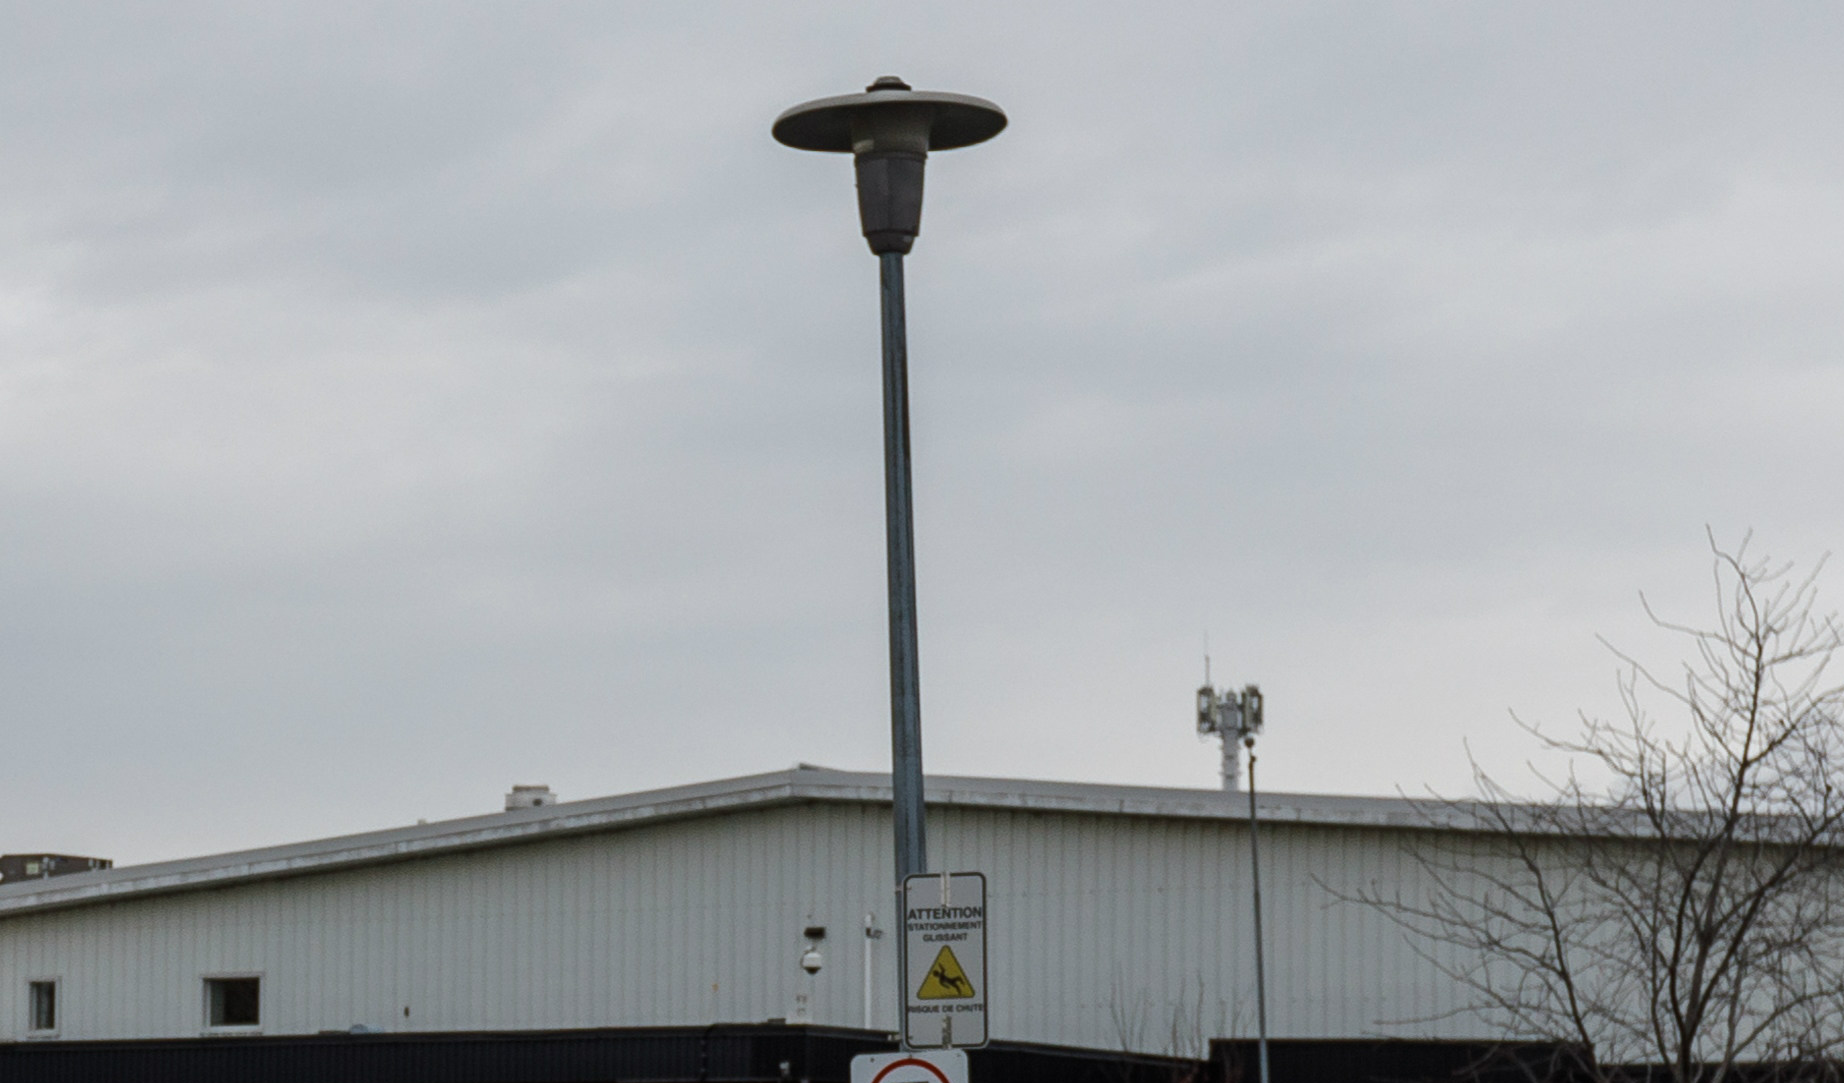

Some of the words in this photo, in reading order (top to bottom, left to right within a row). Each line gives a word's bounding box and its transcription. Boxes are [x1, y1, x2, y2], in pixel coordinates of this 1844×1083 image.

[908, 907, 982, 920] ATTENTION
[907, 921, 982, 932] STATIONNEMENT
[922, 932, 968, 942] GLISSANT
[908, 1004, 940, 1013] RISQUE
[941, 1003, 954, 1013] DE
[956, 1003, 983, 1013] CHUTE
